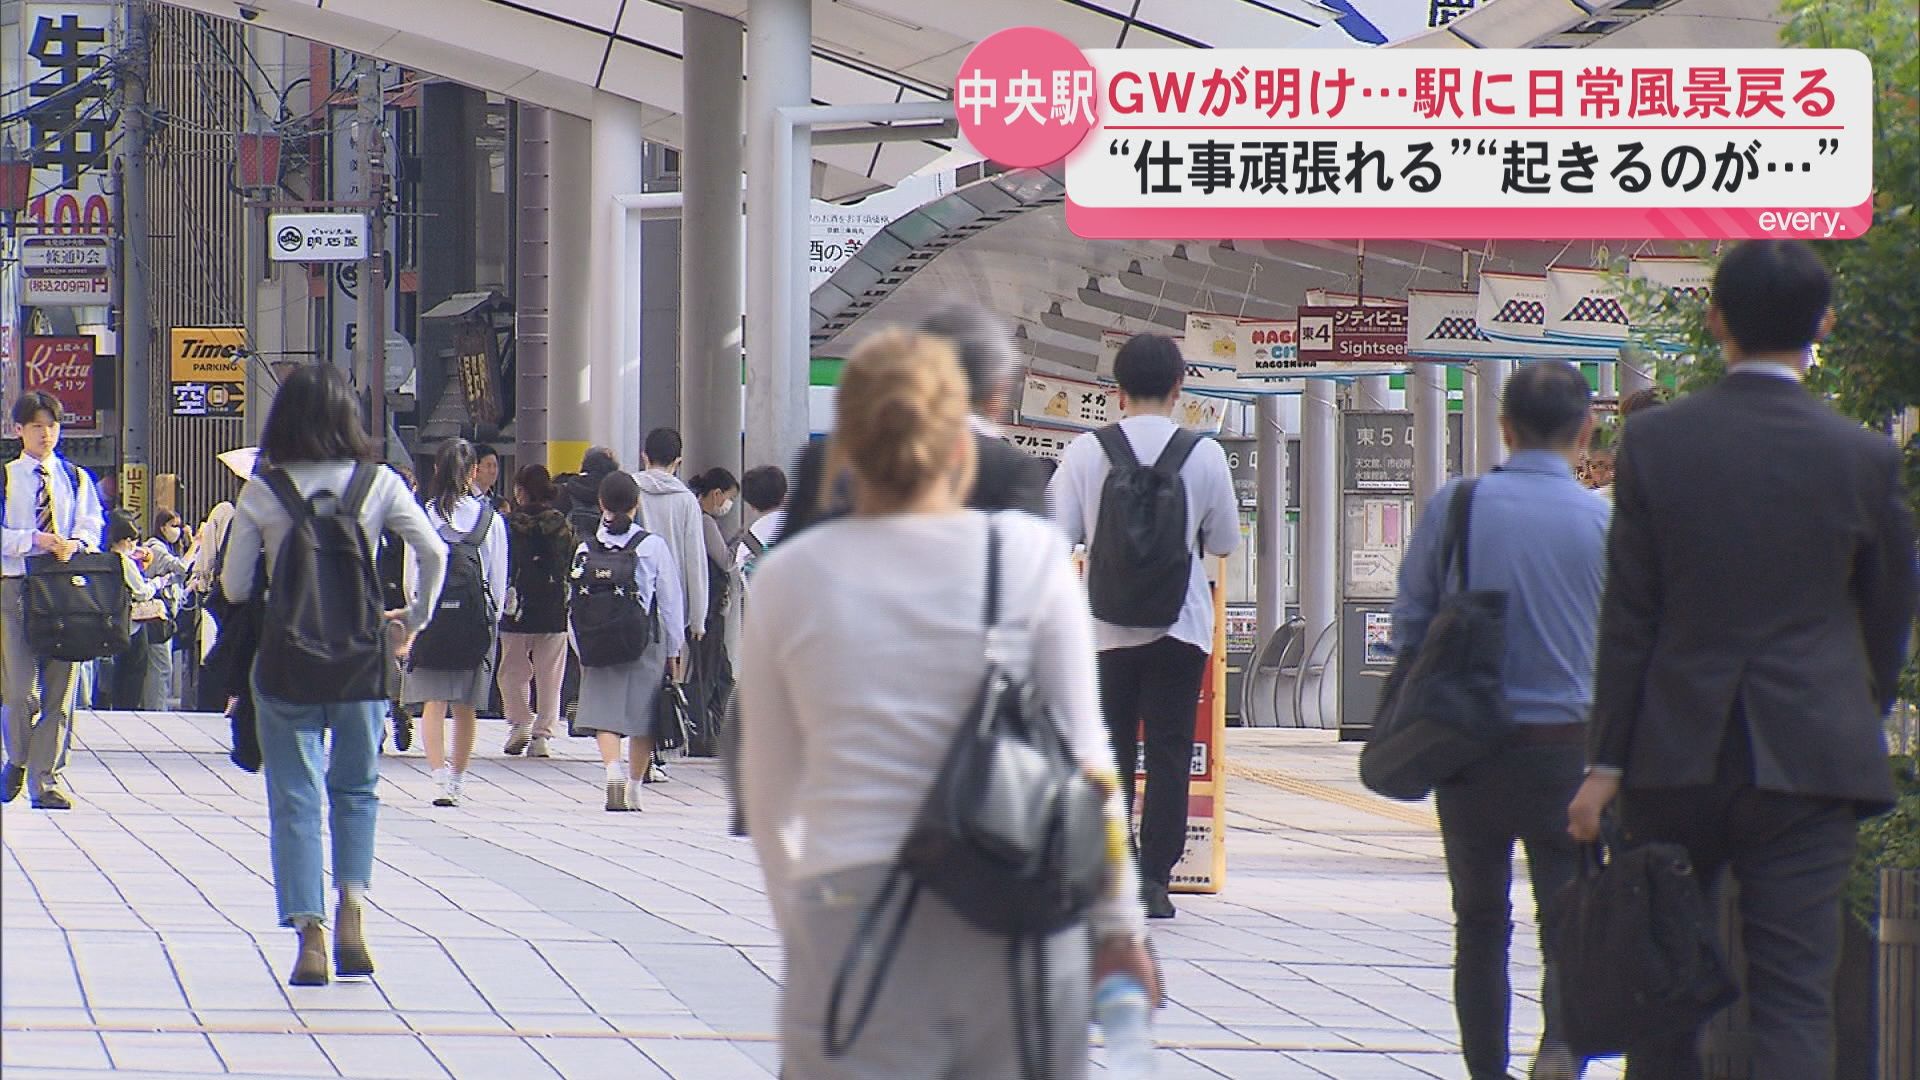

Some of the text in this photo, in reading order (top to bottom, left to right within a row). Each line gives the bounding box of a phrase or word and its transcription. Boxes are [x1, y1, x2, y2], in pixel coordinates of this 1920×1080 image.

[1251, 330, 1297, 344] MAG
[193, 363, 238, 371] PARKING
[53, 380, 86, 391] キリツ
[173, 382, 206, 414] 空
